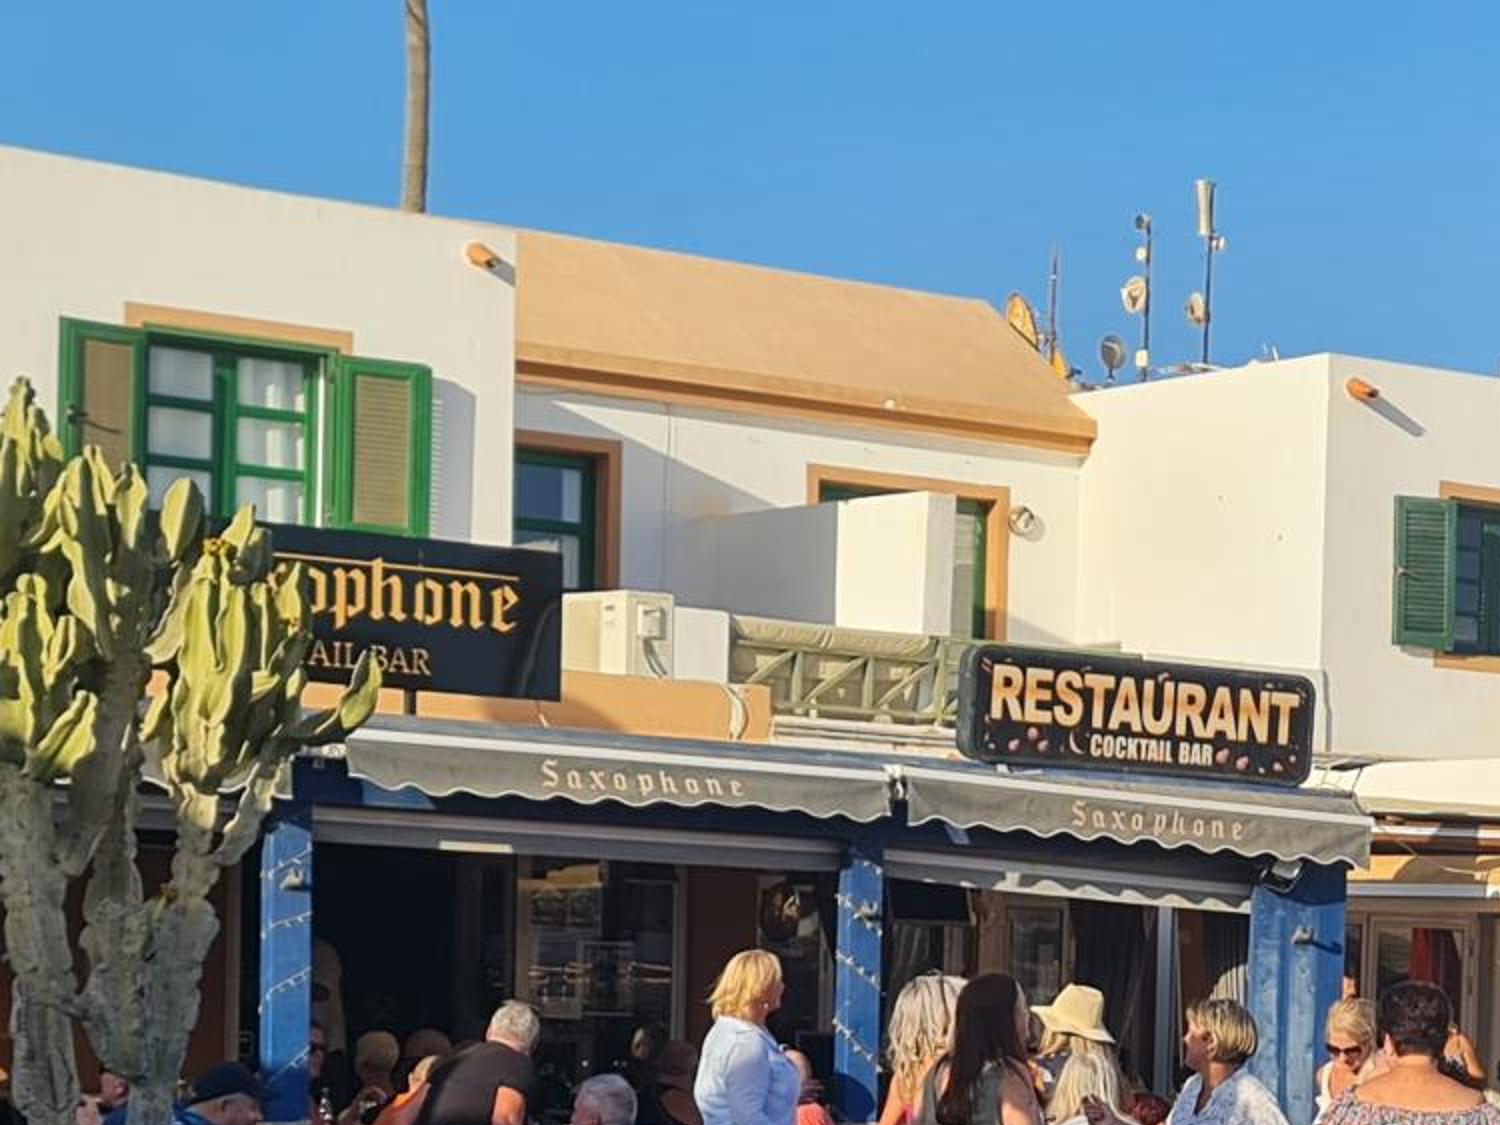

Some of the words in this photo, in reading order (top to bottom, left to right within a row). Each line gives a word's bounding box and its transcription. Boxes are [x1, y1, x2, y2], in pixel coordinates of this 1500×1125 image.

[370, 645, 432, 677] BAR
[1089, 733, 1173, 764] COCKTAIL
[1177, 739, 1213, 768] BAR
[541, 758, 746, 799] Saxophone
[1070, 802, 1245, 840] Saxophone
